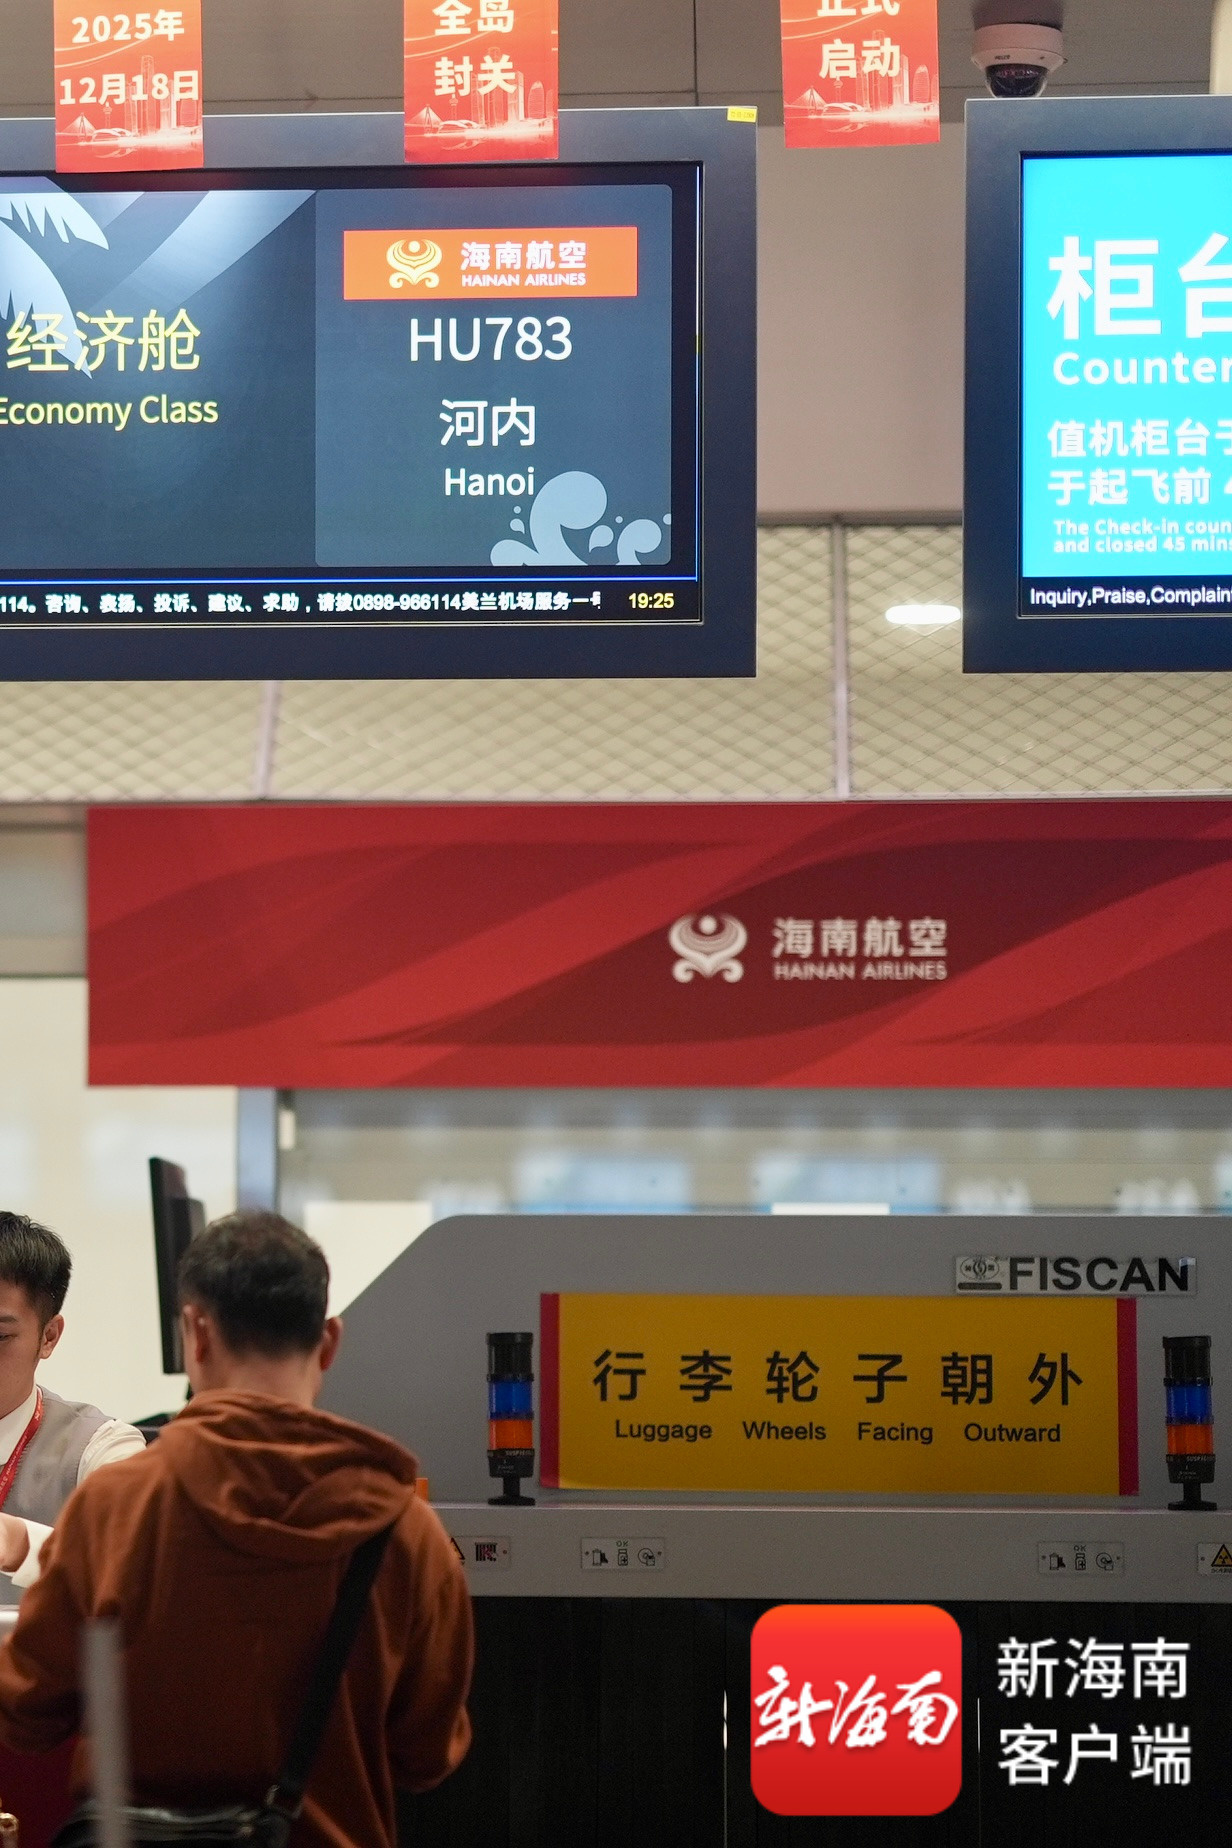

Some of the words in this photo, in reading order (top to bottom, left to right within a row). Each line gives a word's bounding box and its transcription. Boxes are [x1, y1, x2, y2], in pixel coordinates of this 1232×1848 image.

[71, 8, 185, 44] 2025年
[432, 0, 515, 36] 全岛
[433, 54, 518, 96] 封关
[818, 37, 901, 79] 启动
[58, 69, 199, 107] 12月18日
[460, 240, 587, 271] 海南航空
[461, 273, 520, 288] HAINAN
[524, 272, 587, 287] AIRLINES
[5, 308, 202, 372] 经济舱
[410, 316, 573, 362] HU783
[139, 394, 219, 425] Class
[439, 397, 536, 447] 河内
[444, 466, 535, 496] Hanoi
[1047, 466, 1212, 506] 于起飞前
[1053, 537, 1090, 553] and
[1095, 535, 1158, 553] closed
[1162, 535, 1186, 552] 45
[1054, 519, 1090, 535] The
[1095, 517, 1180, 535] Check-in
[628, 592, 675, 609] 19:25
[772, 916, 947, 959] 海南航空
[773, 961, 856, 981] HAINAN
[862, 960, 948, 981] AIRLINES
[1009, 1256, 1189, 1292] FISCAN
[592, 1348, 1083, 1407] 行李轮子朝外
[614, 1418, 713, 1442] Luggage
[742, 1420, 827, 1442] Wheels
[856, 1421, 935, 1446] Facing
[963, 1422, 1062, 1444] Outward
